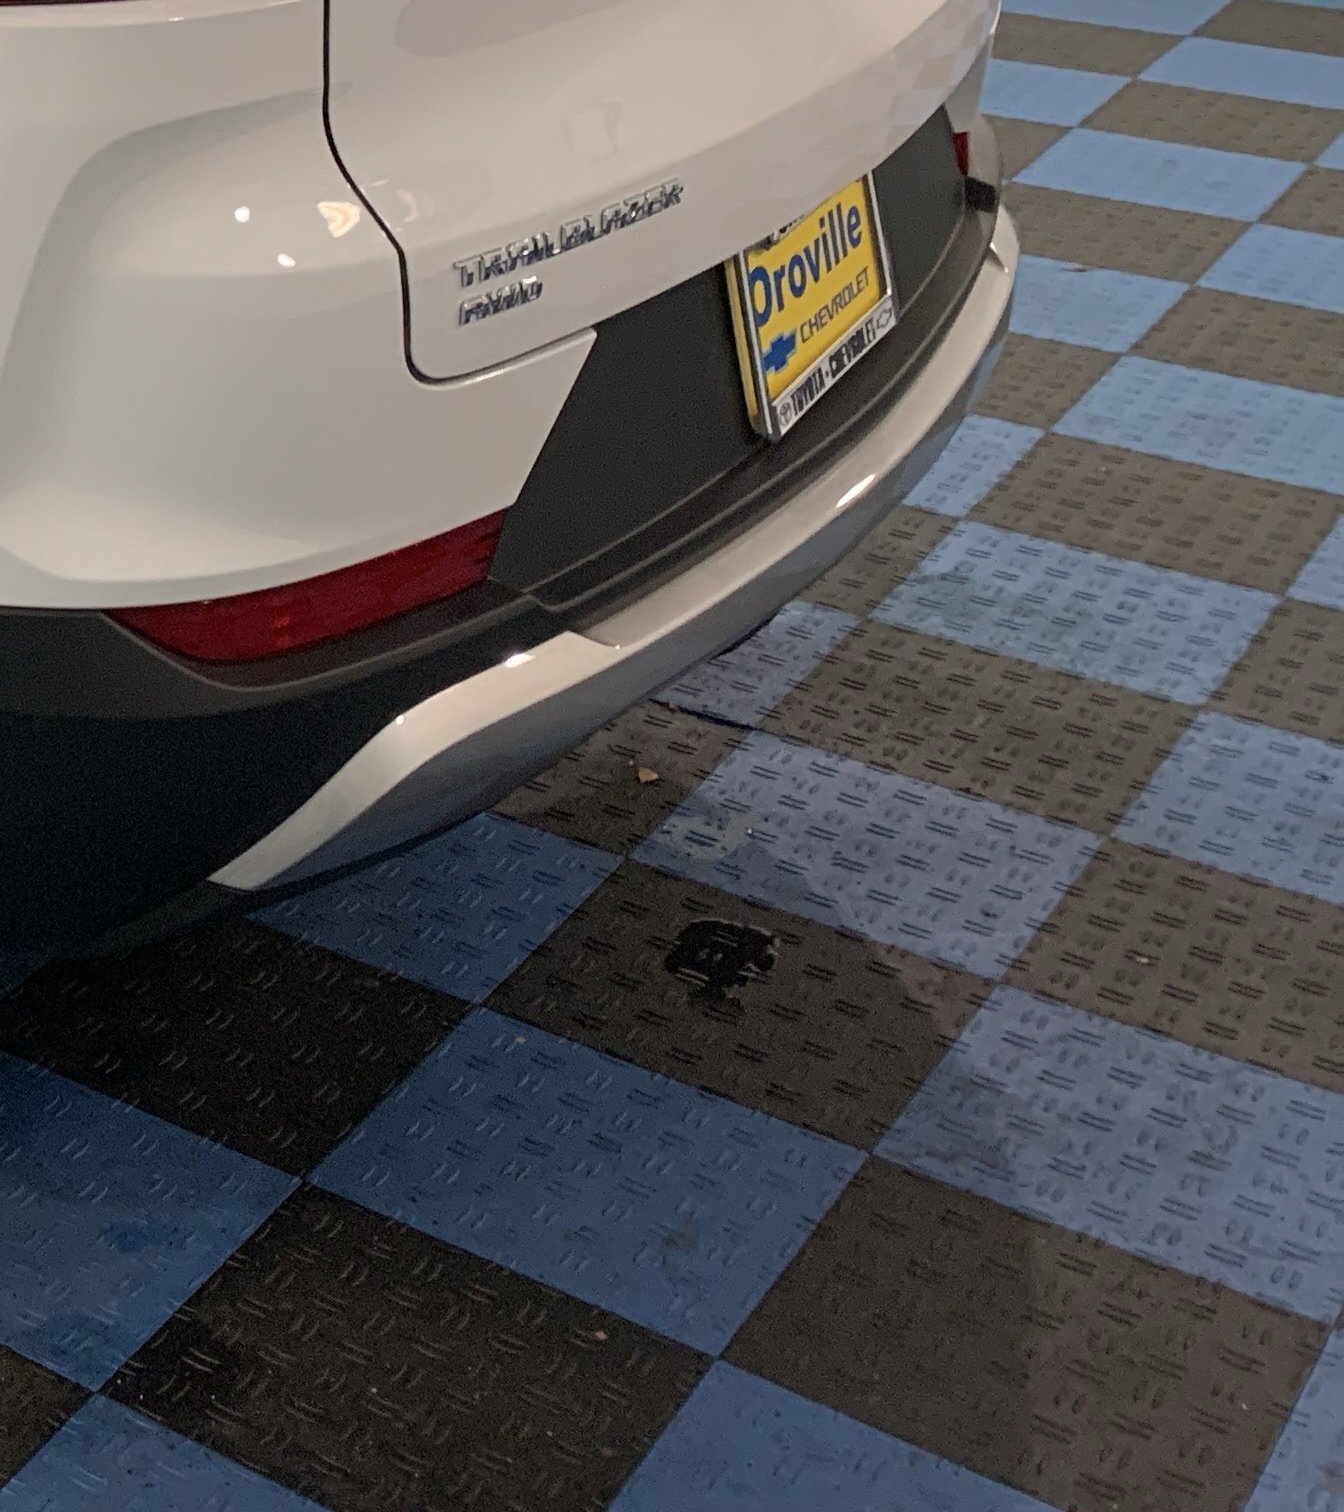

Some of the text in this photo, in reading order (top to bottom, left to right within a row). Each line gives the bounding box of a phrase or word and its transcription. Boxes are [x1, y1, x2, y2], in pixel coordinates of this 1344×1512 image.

[452, 176, 685, 288] TRAILBLAZER
[748, 202, 863, 330] Oroville
[799, 264, 871, 345] CHEVROLET
[829, 317, 877, 379] CHEVROLET
